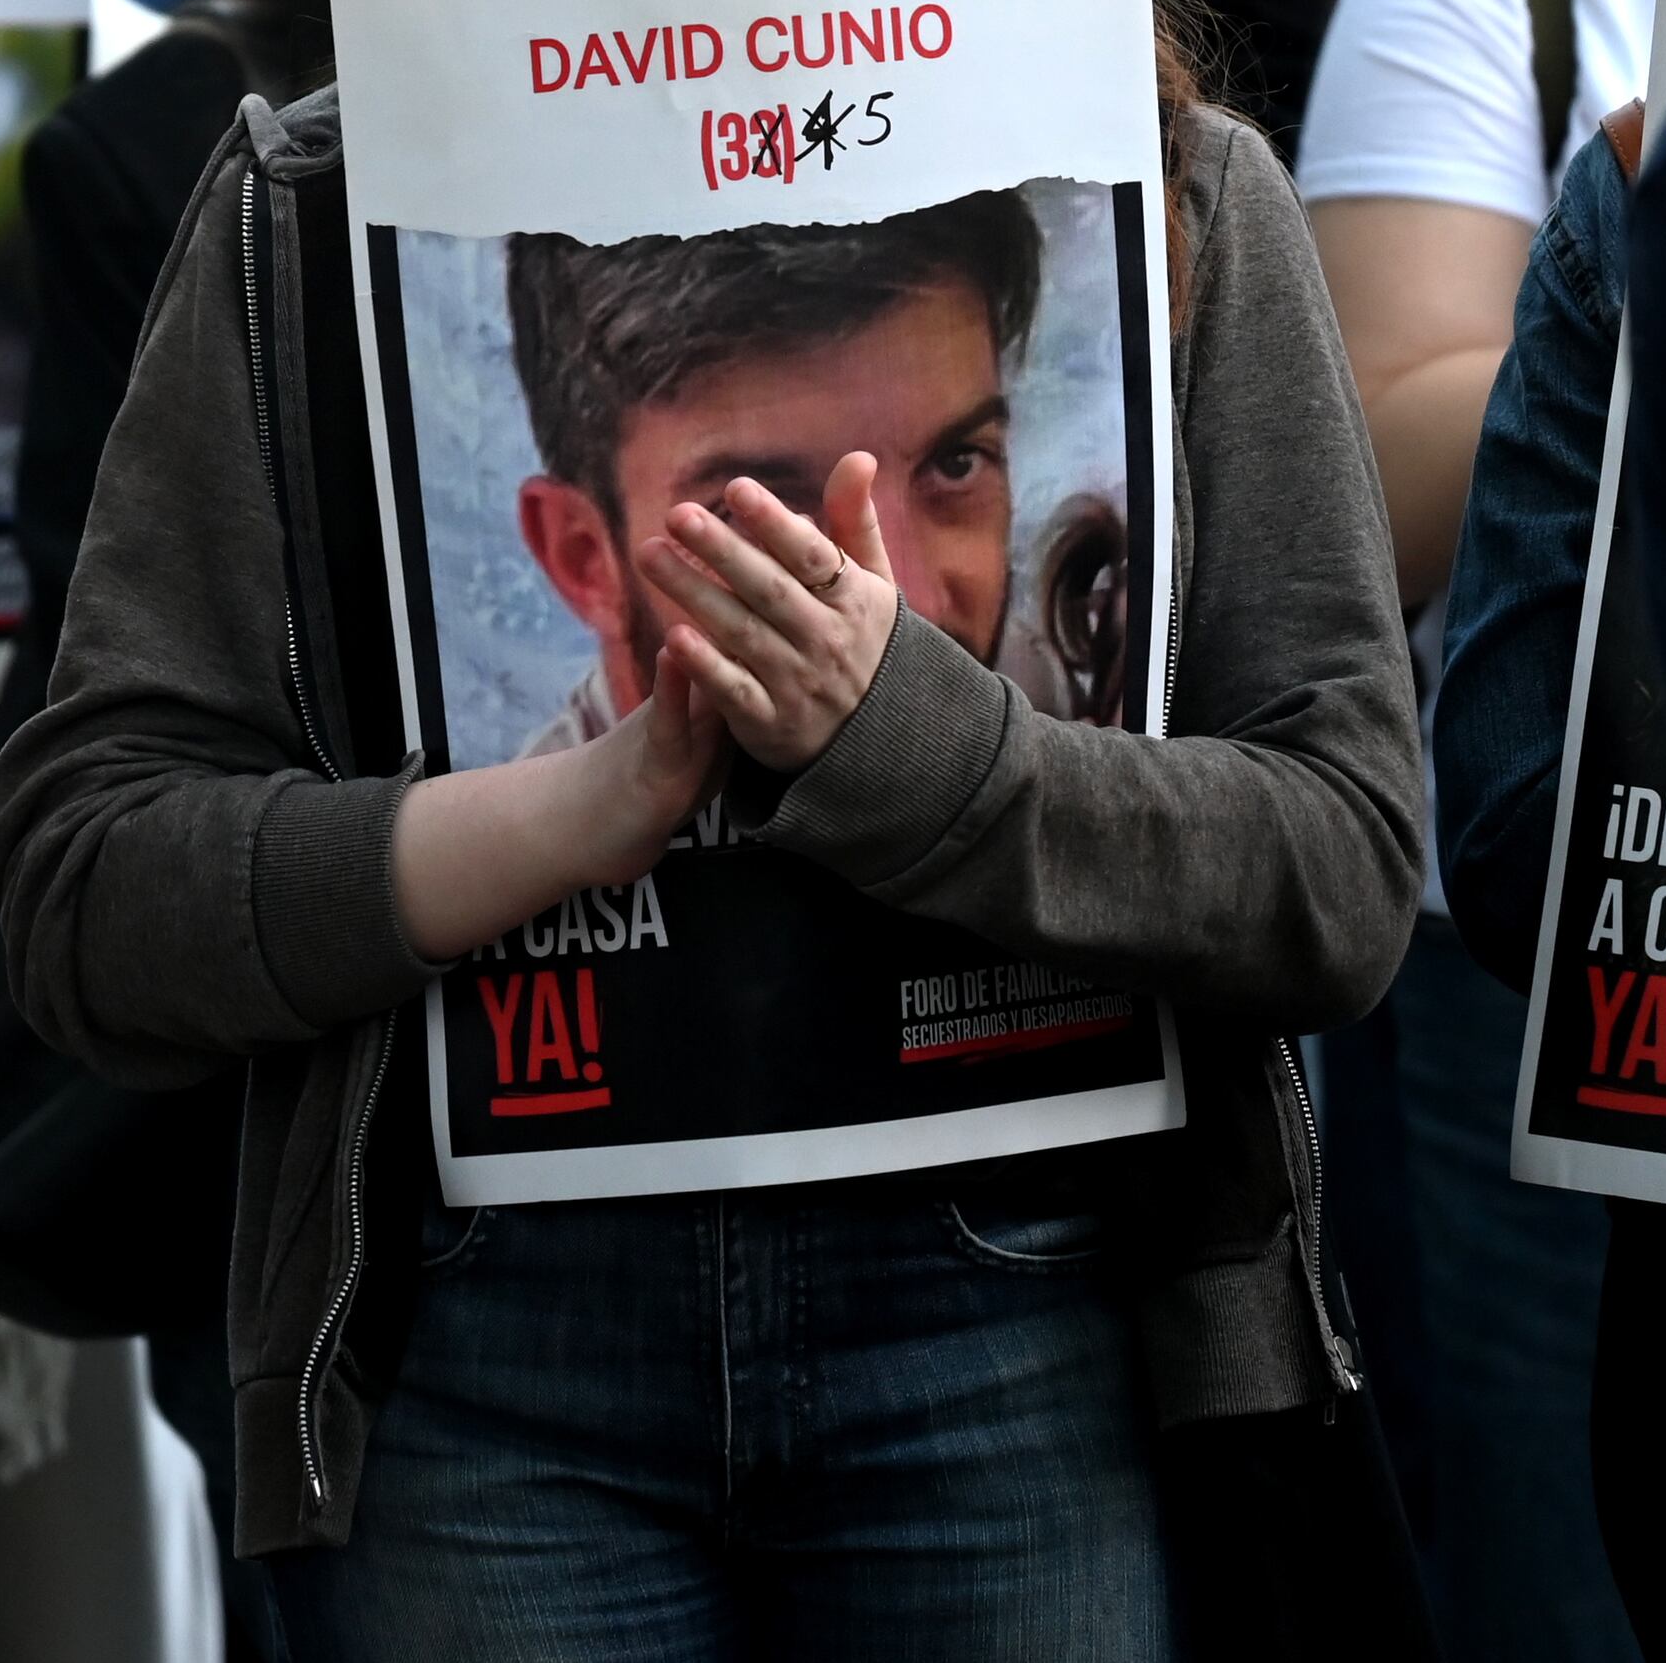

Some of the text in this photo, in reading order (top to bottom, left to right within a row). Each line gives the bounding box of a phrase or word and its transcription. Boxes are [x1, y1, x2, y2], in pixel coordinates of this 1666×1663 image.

[529, 3, 953, 94] DAVID CUNIO
[857, 91, 894, 146] 5
[1587, 877, 1625, 956] A
[476, 966, 605, 1085] YA!
[899, 973, 958, 1020] FORO
[961, 967, 990, 1010] DE
[902, 992, 1134, 1051] SECUESTRADOS Y DESAPARECIDOS
